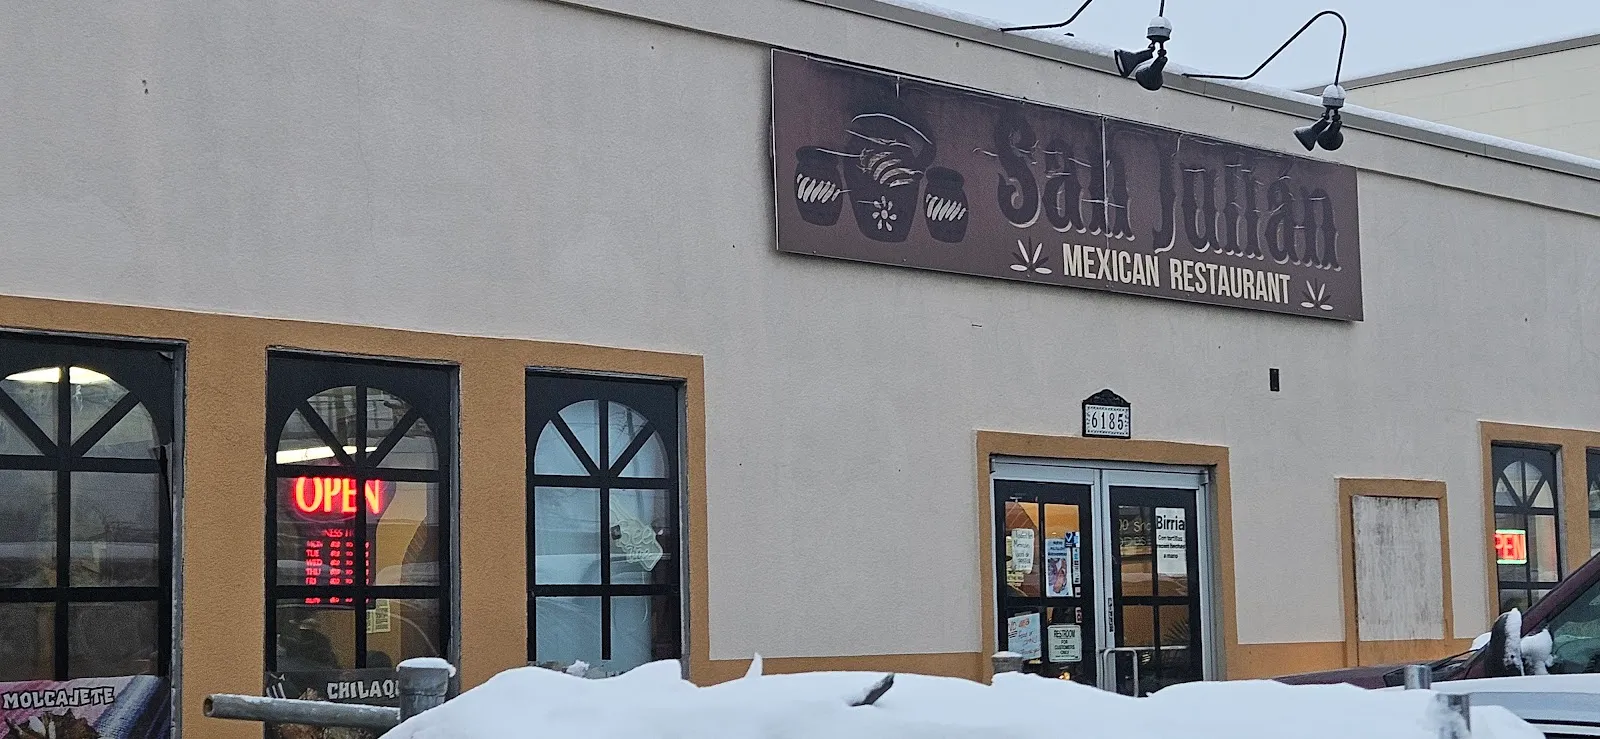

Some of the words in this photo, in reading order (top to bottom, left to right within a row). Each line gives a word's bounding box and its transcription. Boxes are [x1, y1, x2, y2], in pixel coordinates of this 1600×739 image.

[995, 110, 1136, 241] San
[1063, 242, 1160, 288] MEXICAN
[1169, 258, 1291, 304] RESTAURANT
[1091, 411, 1124, 430] 6185
[295, 476, 381, 514] OPEN
[1156, 515, 1185, 530] Birria
[1492, 533, 1525, 559] PEN
[2, 686, 115, 710] MOLCAJETE
